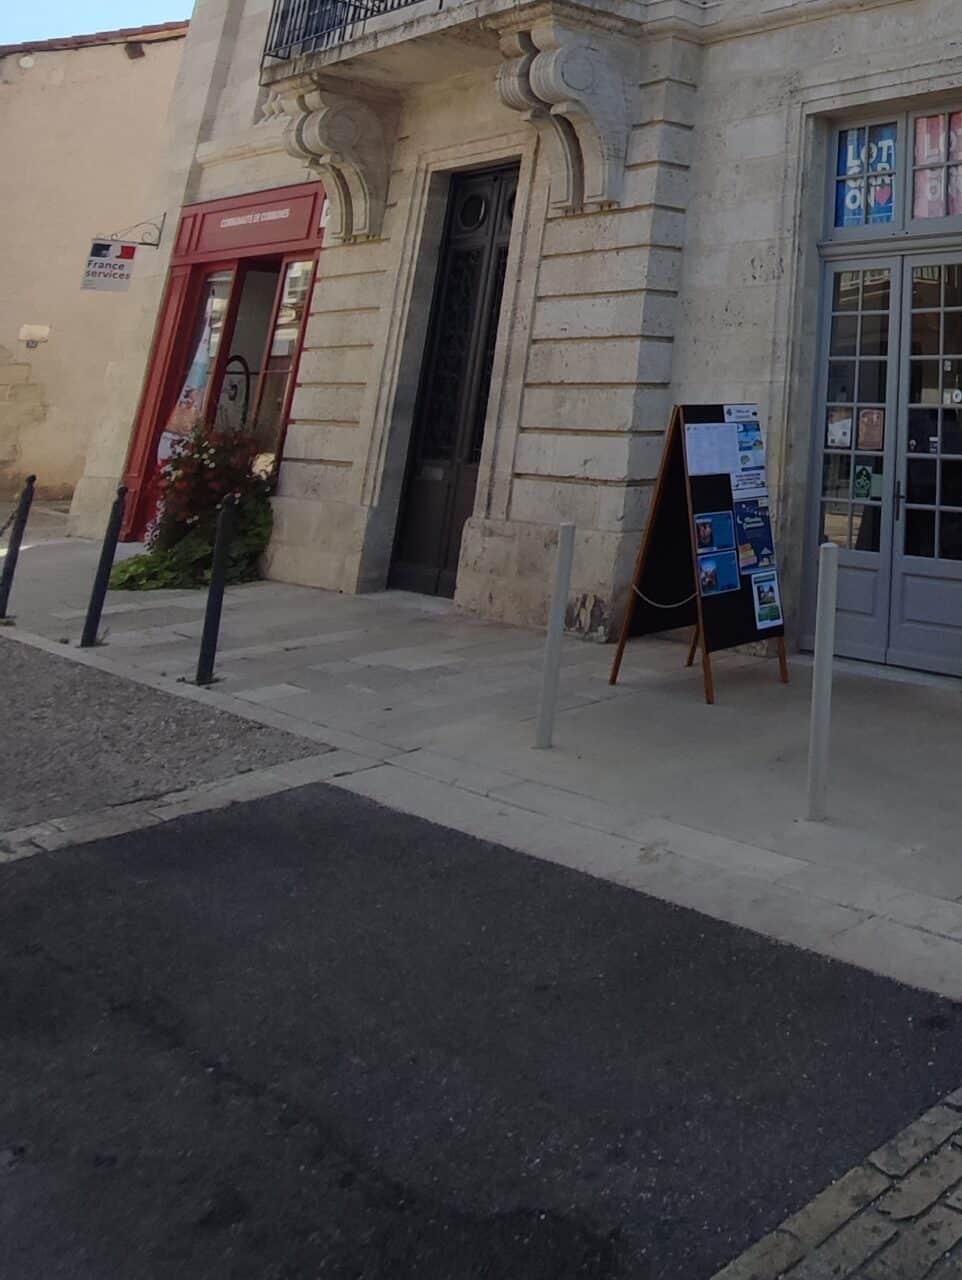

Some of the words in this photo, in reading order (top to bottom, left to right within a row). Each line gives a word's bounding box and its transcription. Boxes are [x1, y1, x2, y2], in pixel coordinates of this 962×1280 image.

[847, 139, 893, 168] LOT
[87, 259, 126, 271] France
[85, 270, 130, 280] services
